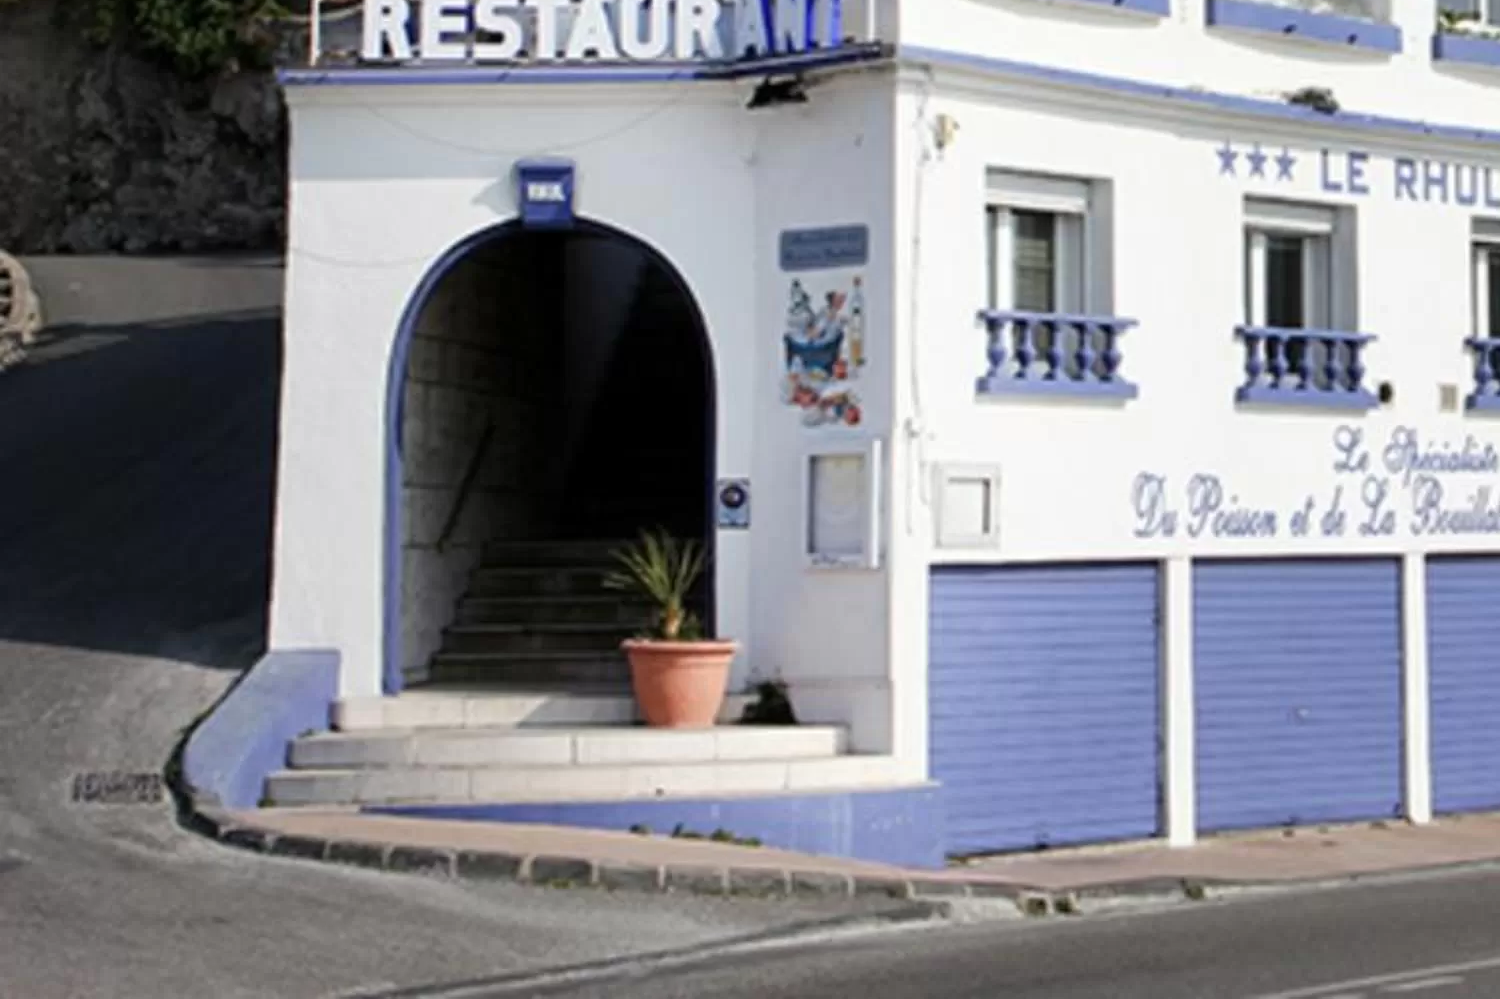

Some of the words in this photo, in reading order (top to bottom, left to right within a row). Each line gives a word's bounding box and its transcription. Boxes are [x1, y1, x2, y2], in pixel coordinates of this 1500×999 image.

[1319, 148, 1370, 194] LE
[1332, 424, 1370, 473] Le
[1382, 424, 1499, 489] Spécialiste
[1131, 471, 1178, 538] Du
[1186, 472, 1277, 538] Poisson
[1289, 495, 1316, 537] et
[1320, 484, 1347, 537] de
[1357, 473, 1397, 537] La
